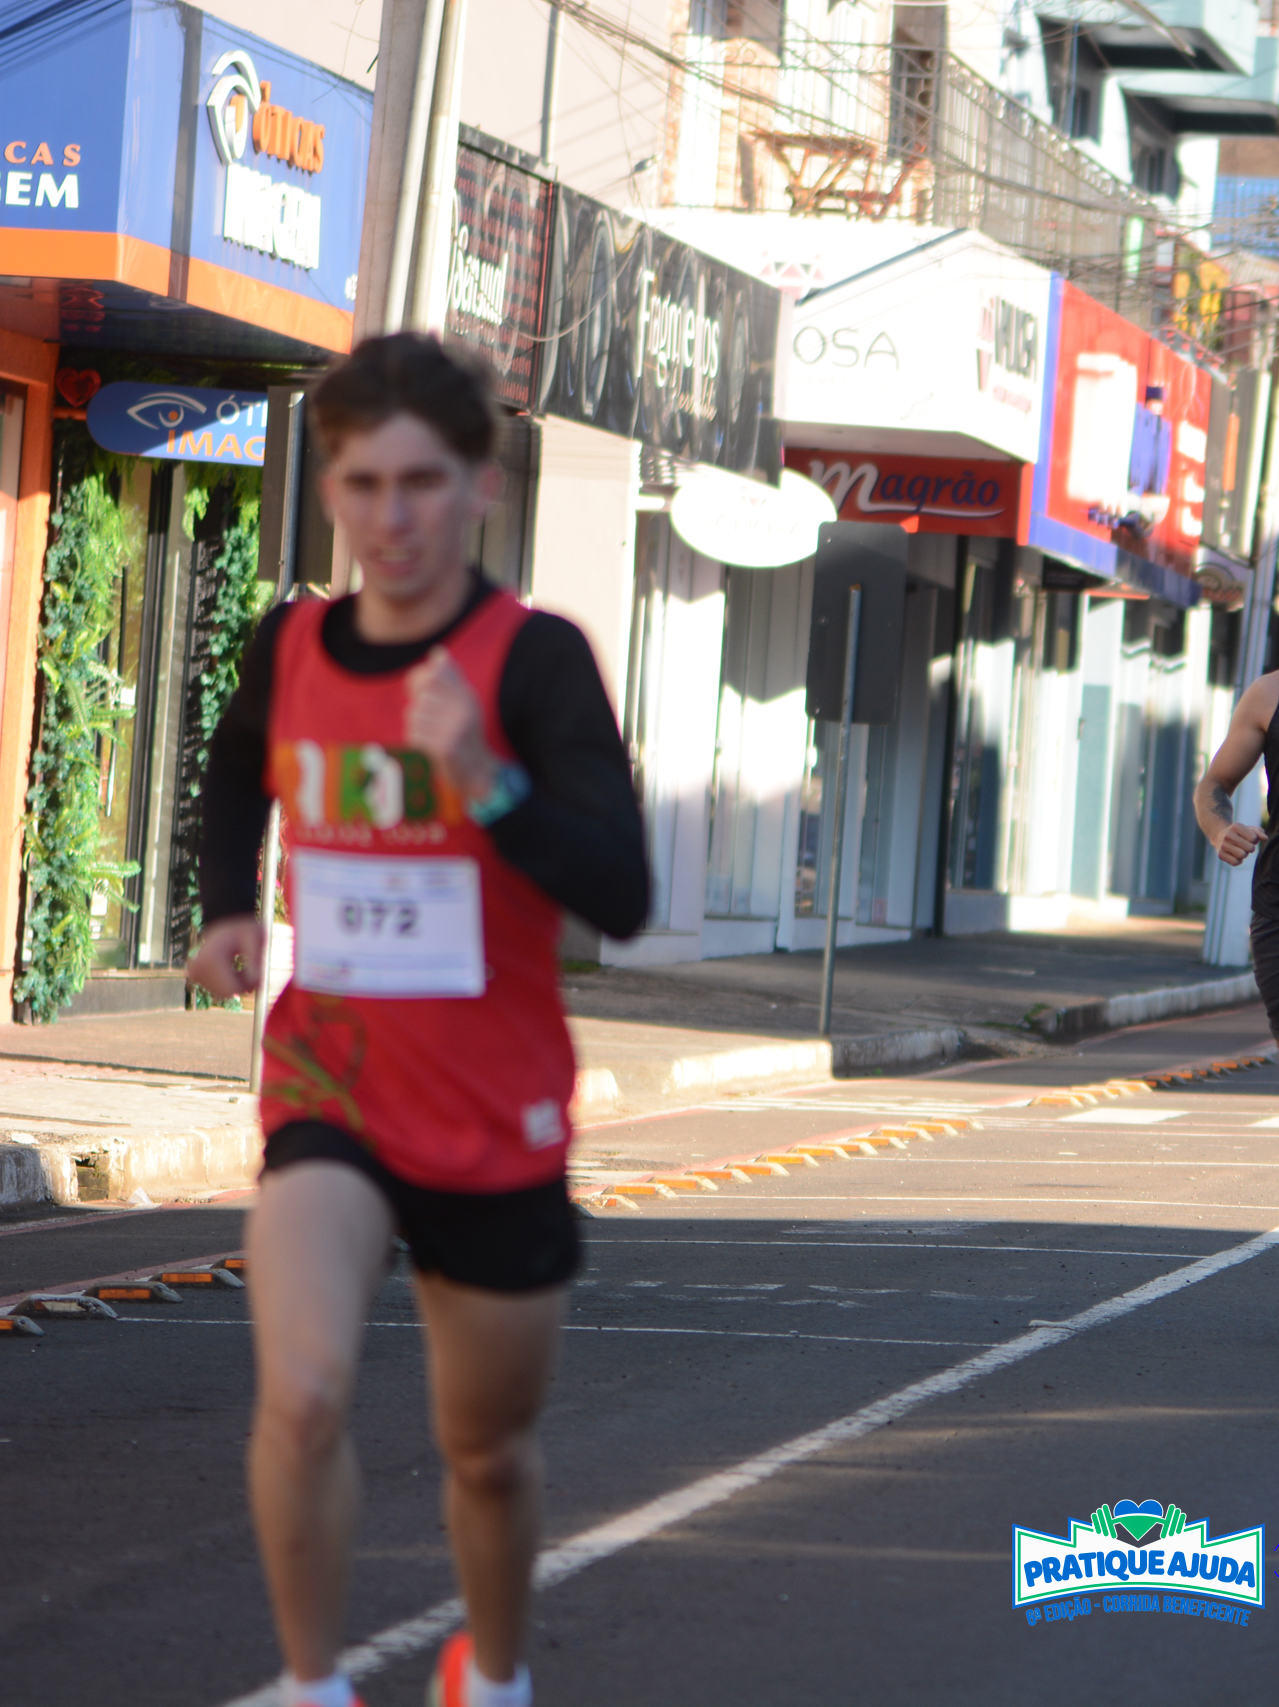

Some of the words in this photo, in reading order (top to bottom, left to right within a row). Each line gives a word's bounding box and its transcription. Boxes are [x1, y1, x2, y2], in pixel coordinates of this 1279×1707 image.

[253, 80, 326, 174] ÓTICAS
[4, 141, 81, 167] CAS
[0, 171, 79, 208] EM
[336, 897, 419, 938] 072
